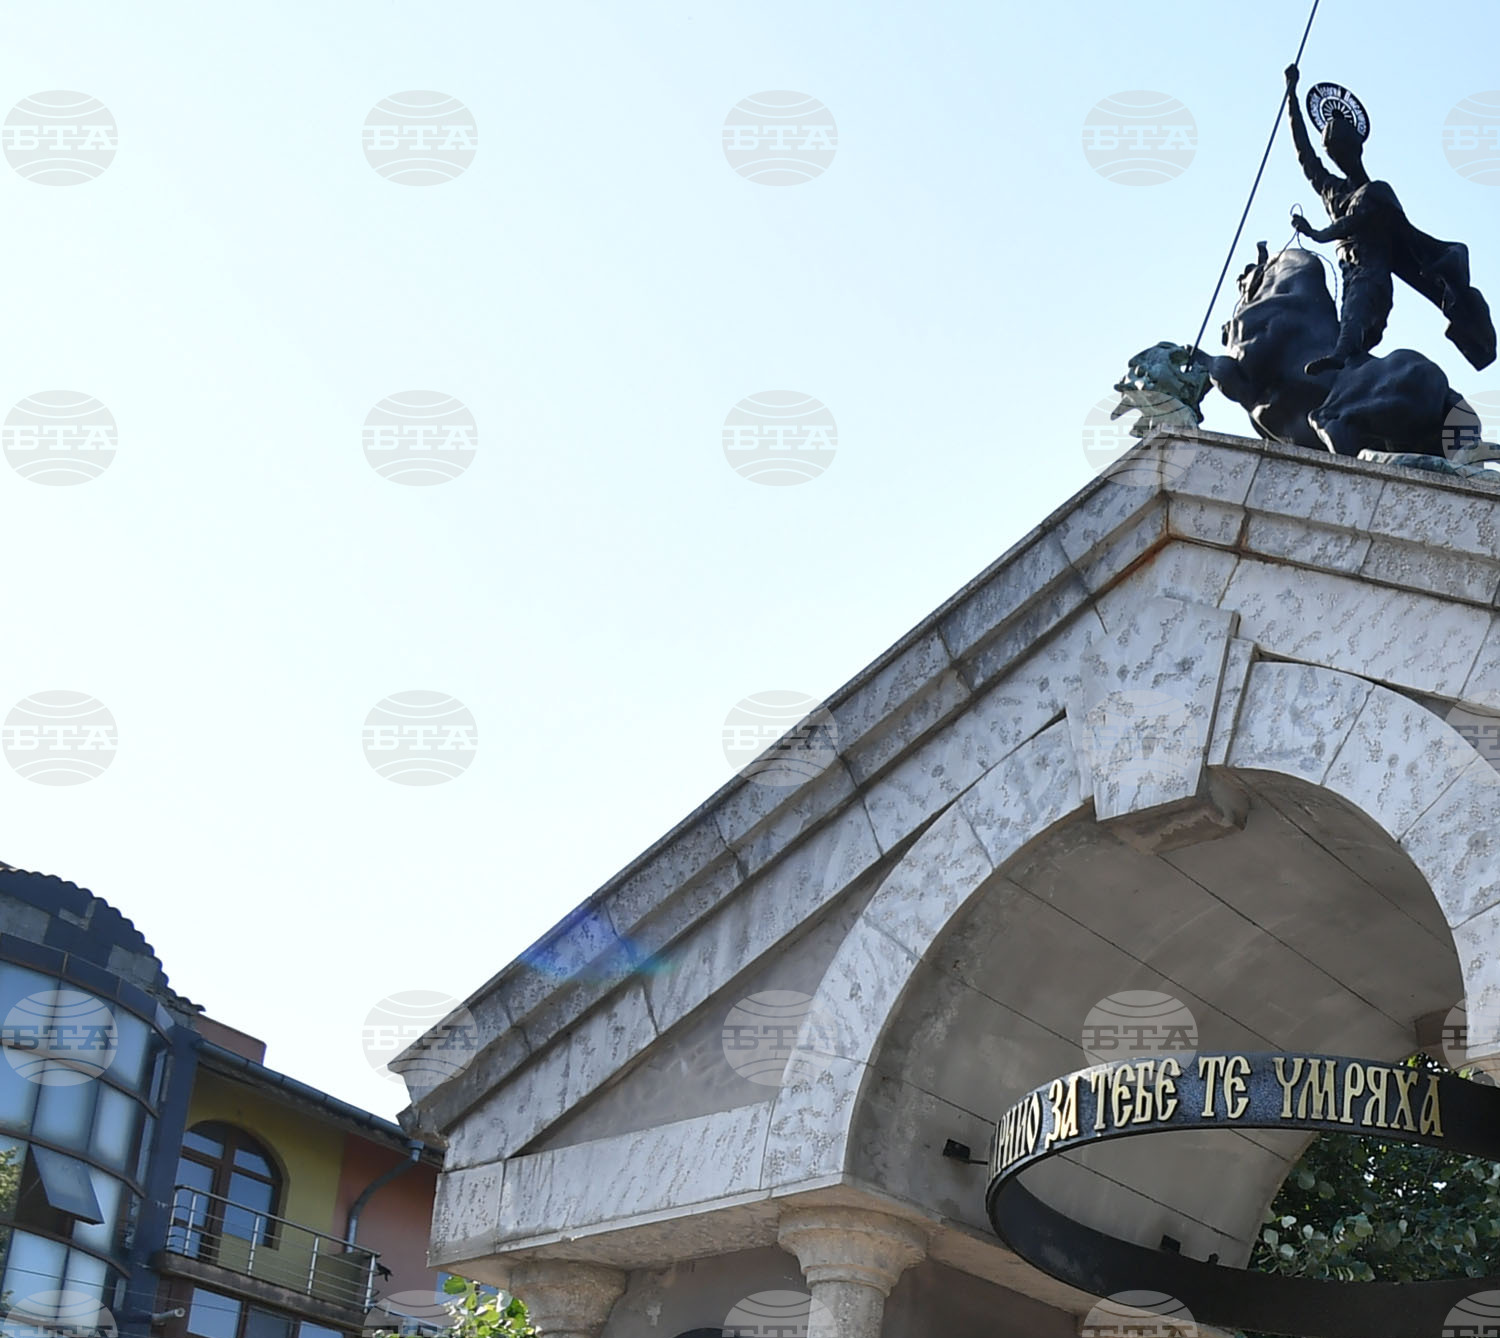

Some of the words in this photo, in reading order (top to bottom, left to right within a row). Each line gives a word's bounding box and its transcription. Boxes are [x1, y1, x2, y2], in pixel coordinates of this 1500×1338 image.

[1045, 1076, 1079, 1149] ЗА
[1091, 1057, 1180, 1131] ТЕБЕ
[1199, 1055, 1251, 1119] ТЕ
[1274, 1056, 1444, 1138] УМРЯХА
